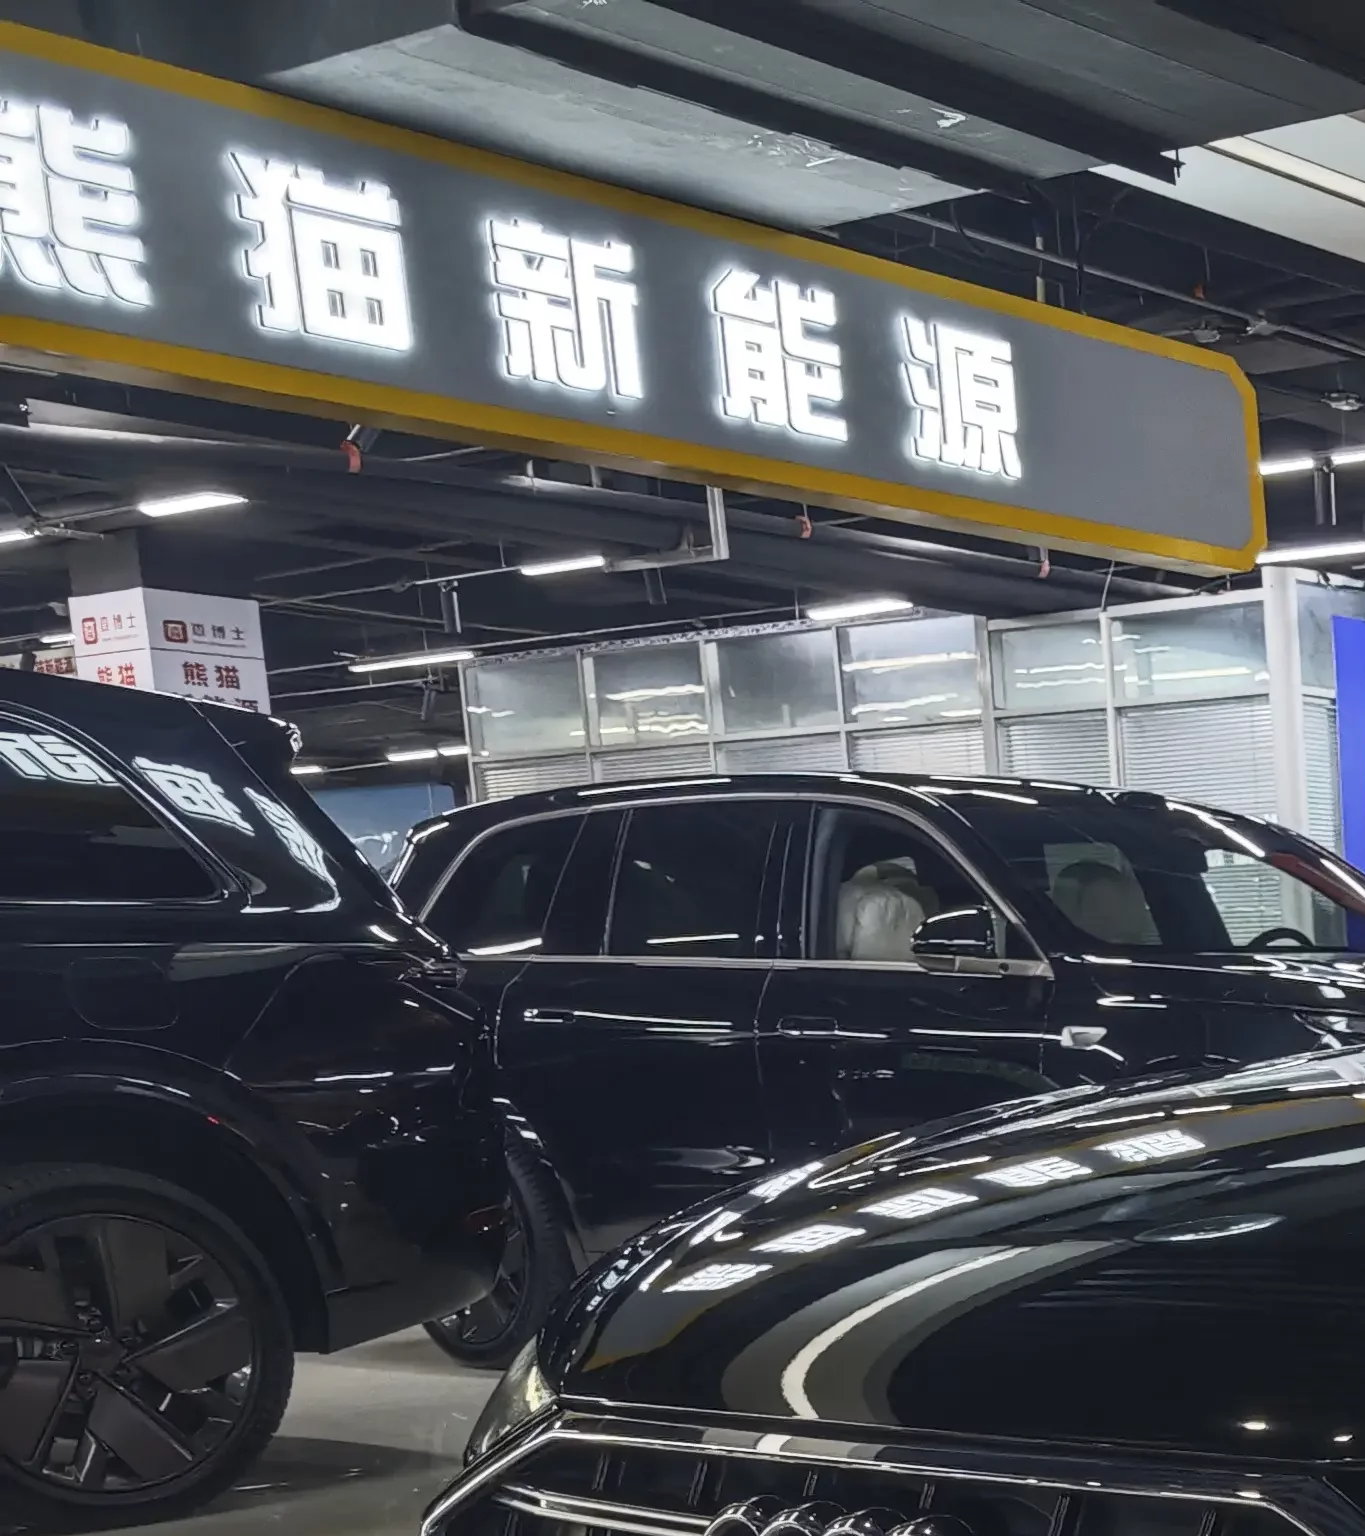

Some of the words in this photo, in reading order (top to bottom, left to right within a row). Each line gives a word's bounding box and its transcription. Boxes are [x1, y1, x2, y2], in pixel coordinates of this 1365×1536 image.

[0, 98, 1023, 481] 熊猫新能源
[182, 660, 241, 690] 熊猫
